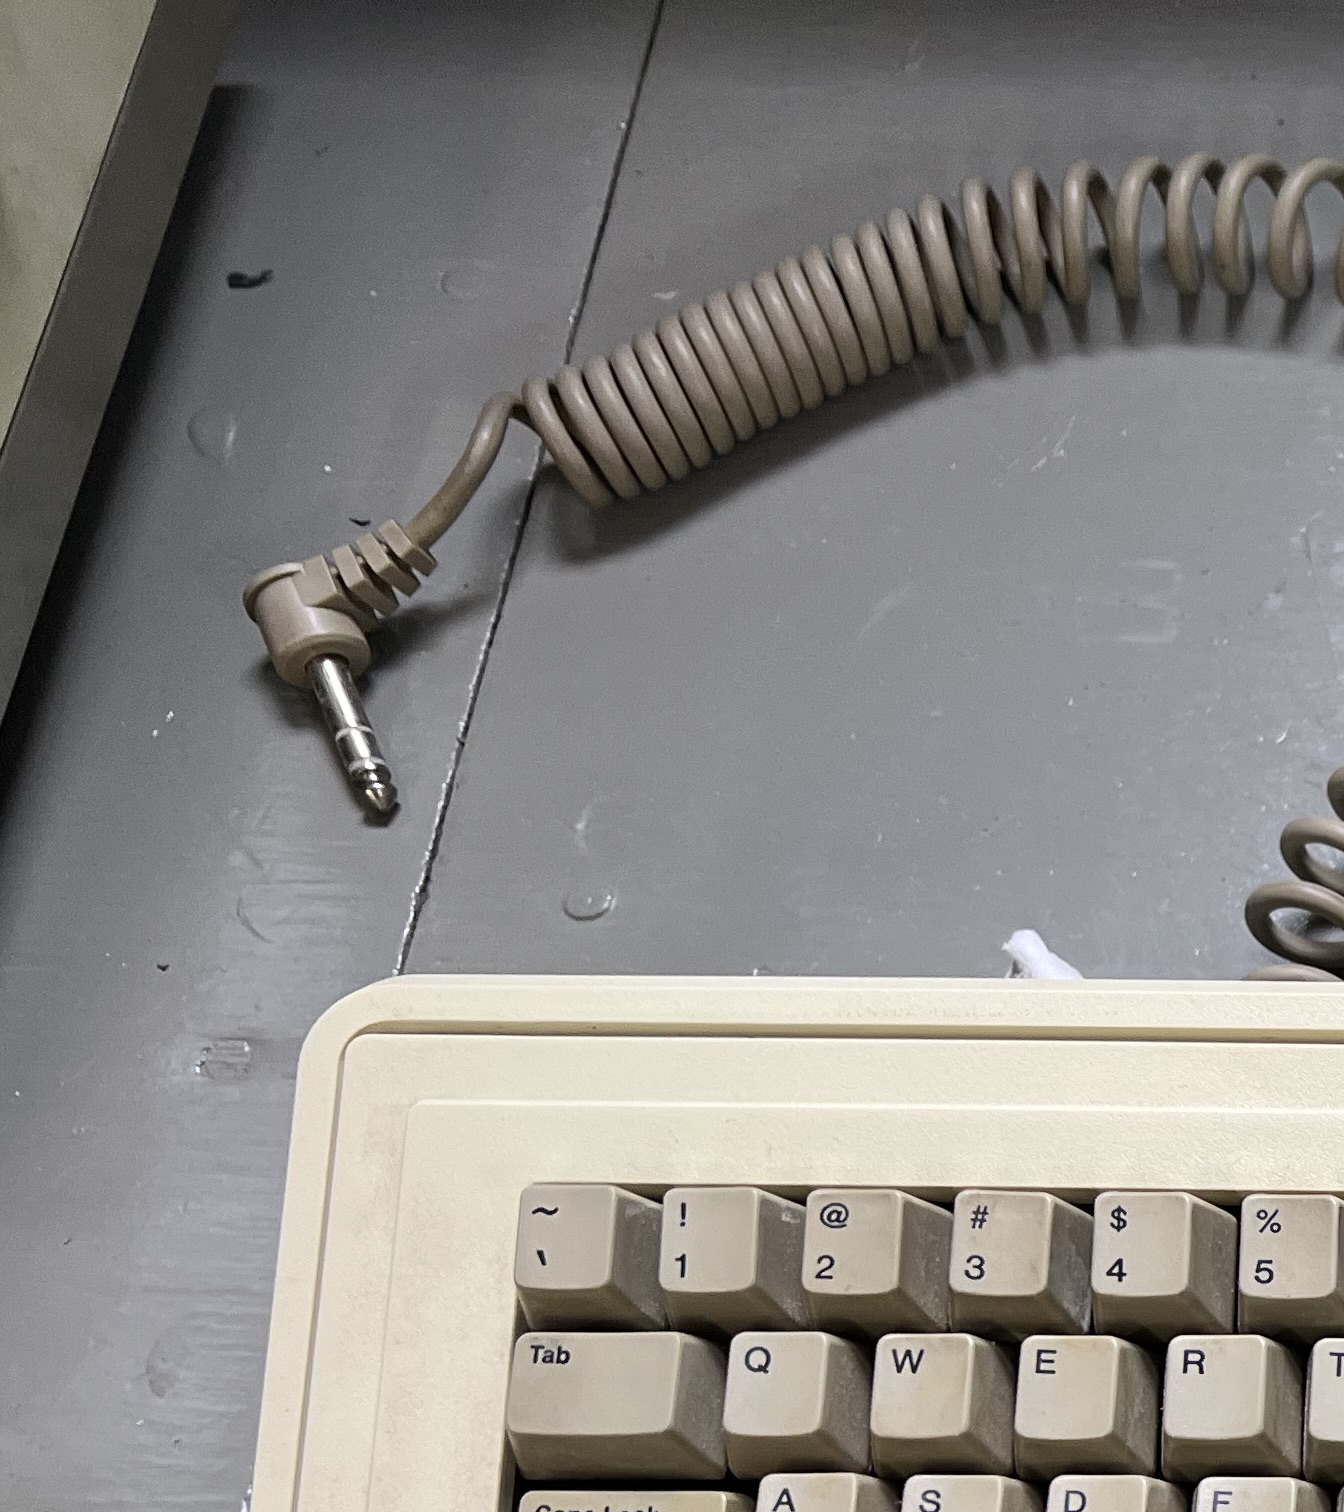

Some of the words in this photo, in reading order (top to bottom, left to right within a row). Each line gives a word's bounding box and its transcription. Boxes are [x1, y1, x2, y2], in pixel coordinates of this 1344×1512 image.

[531, 1206, 559, 1216] ~
[674, 1253, 687, 1279] 1
[814, 1254, 835, 1280] 2
[964, 1254, 986, 1281] 3
[1105, 1257, 1128, 1283] 4
[1254, 1259, 1274, 1285] 5
[530, 1344, 571, 1365] Tab
[744, 1346, 772, 1375] Q
[891, 1348, 925, 1375] W
[1034, 1348, 1057, 1375] E
[1182, 1349, 1206, 1375] R
[772, 1487, 796, 1512] A
